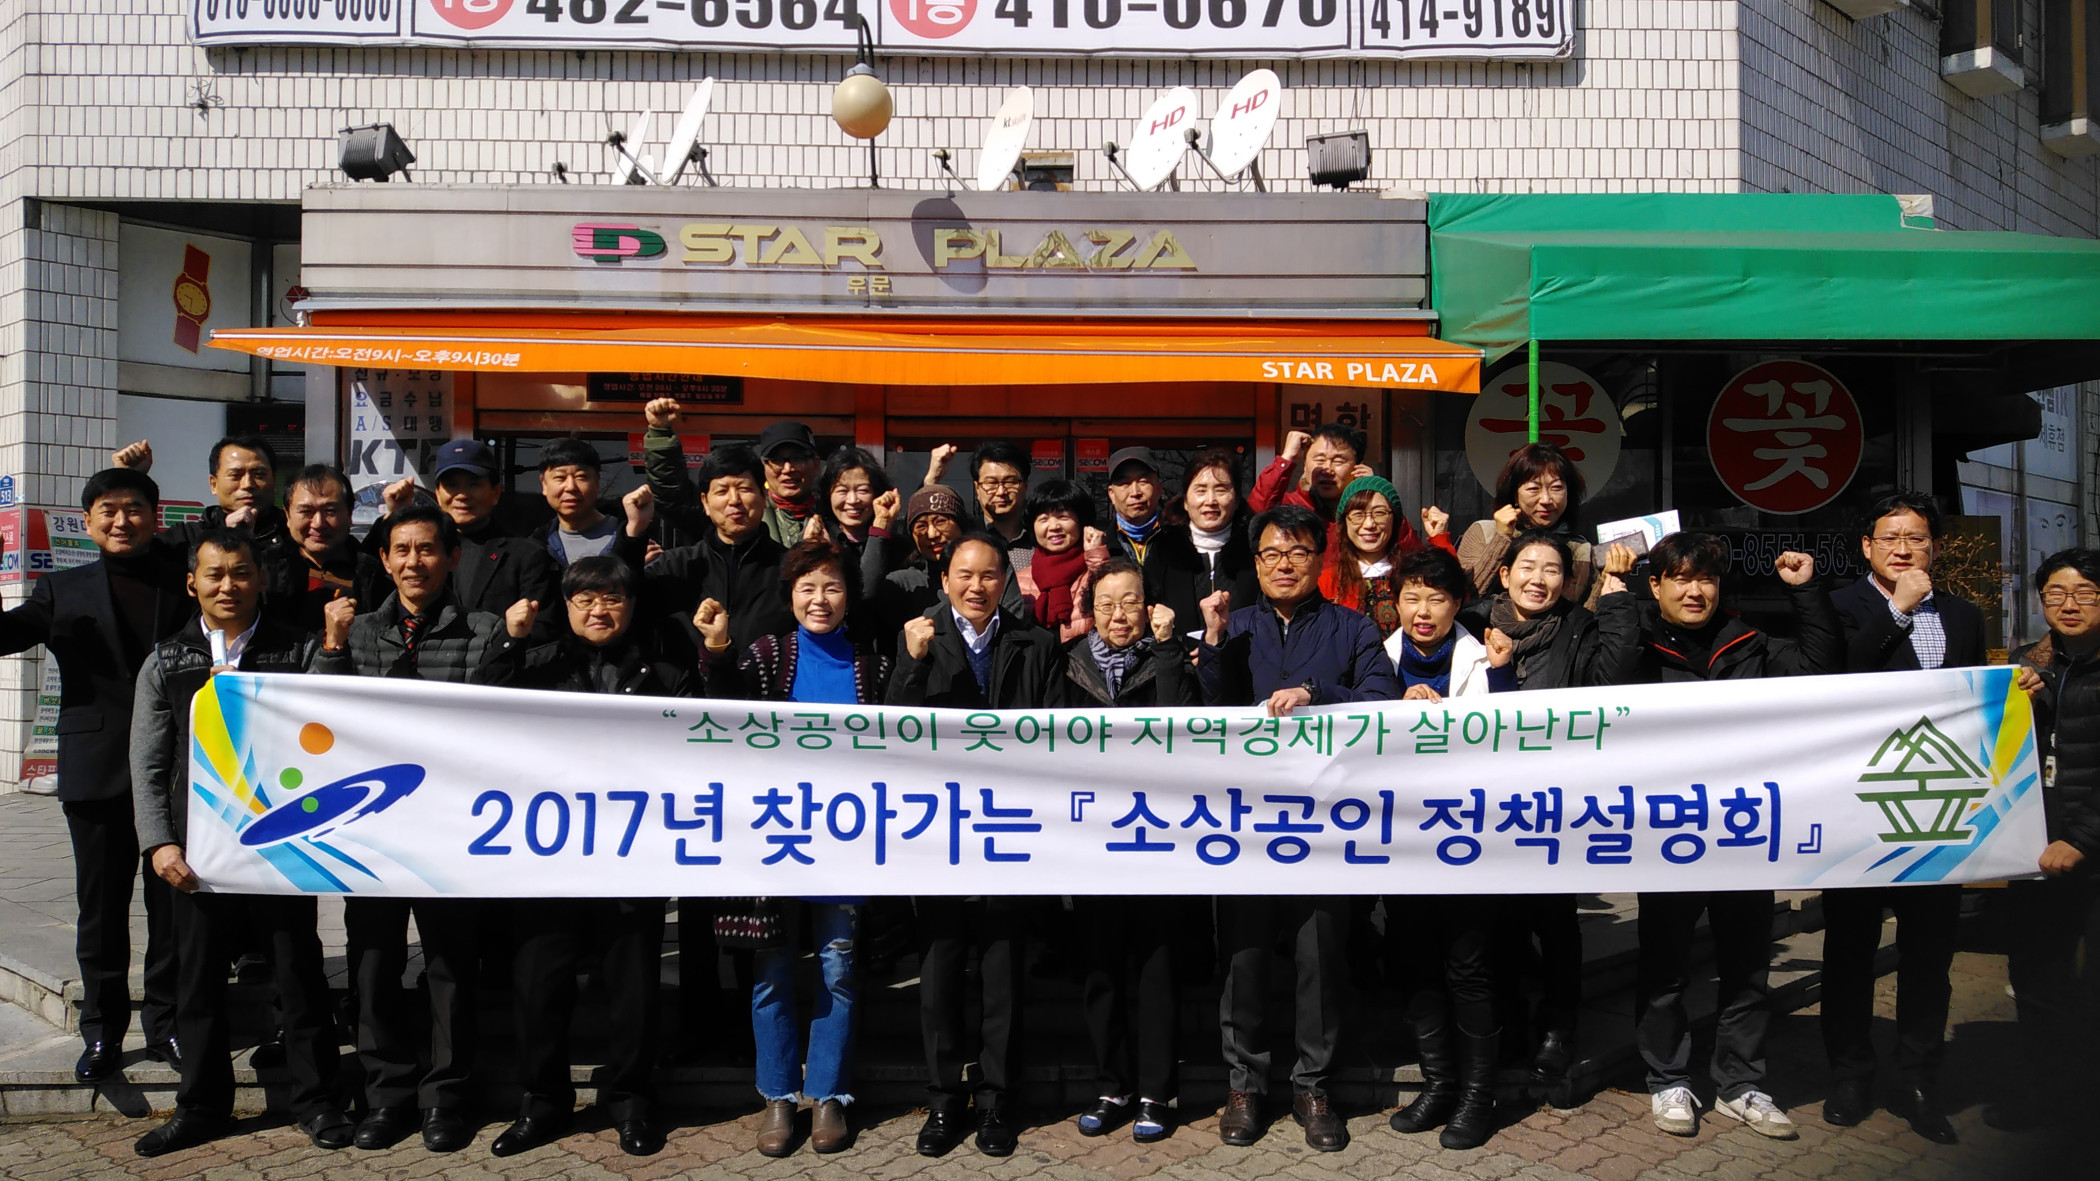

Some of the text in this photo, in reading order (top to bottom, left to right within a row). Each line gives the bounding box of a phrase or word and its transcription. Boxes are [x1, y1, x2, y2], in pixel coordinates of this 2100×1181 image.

[1371, 0, 1554, 40] 414-9189
[1150, 106, 1186, 136] HD
[1231, 89, 1269, 120] HD
[680, 223, 1198, 272] STAR PLAZA
[1262, 361, 1438, 383] STAR PLAZA
[1722, 379, 1847, 490] 꽃
[662, 706, 1631, 757] “소상공인이 웃어야 지역경제가 살아난다”
[467, 782, 724, 866] 2017년
[750, 781, 1043, 866] 찾아가는
